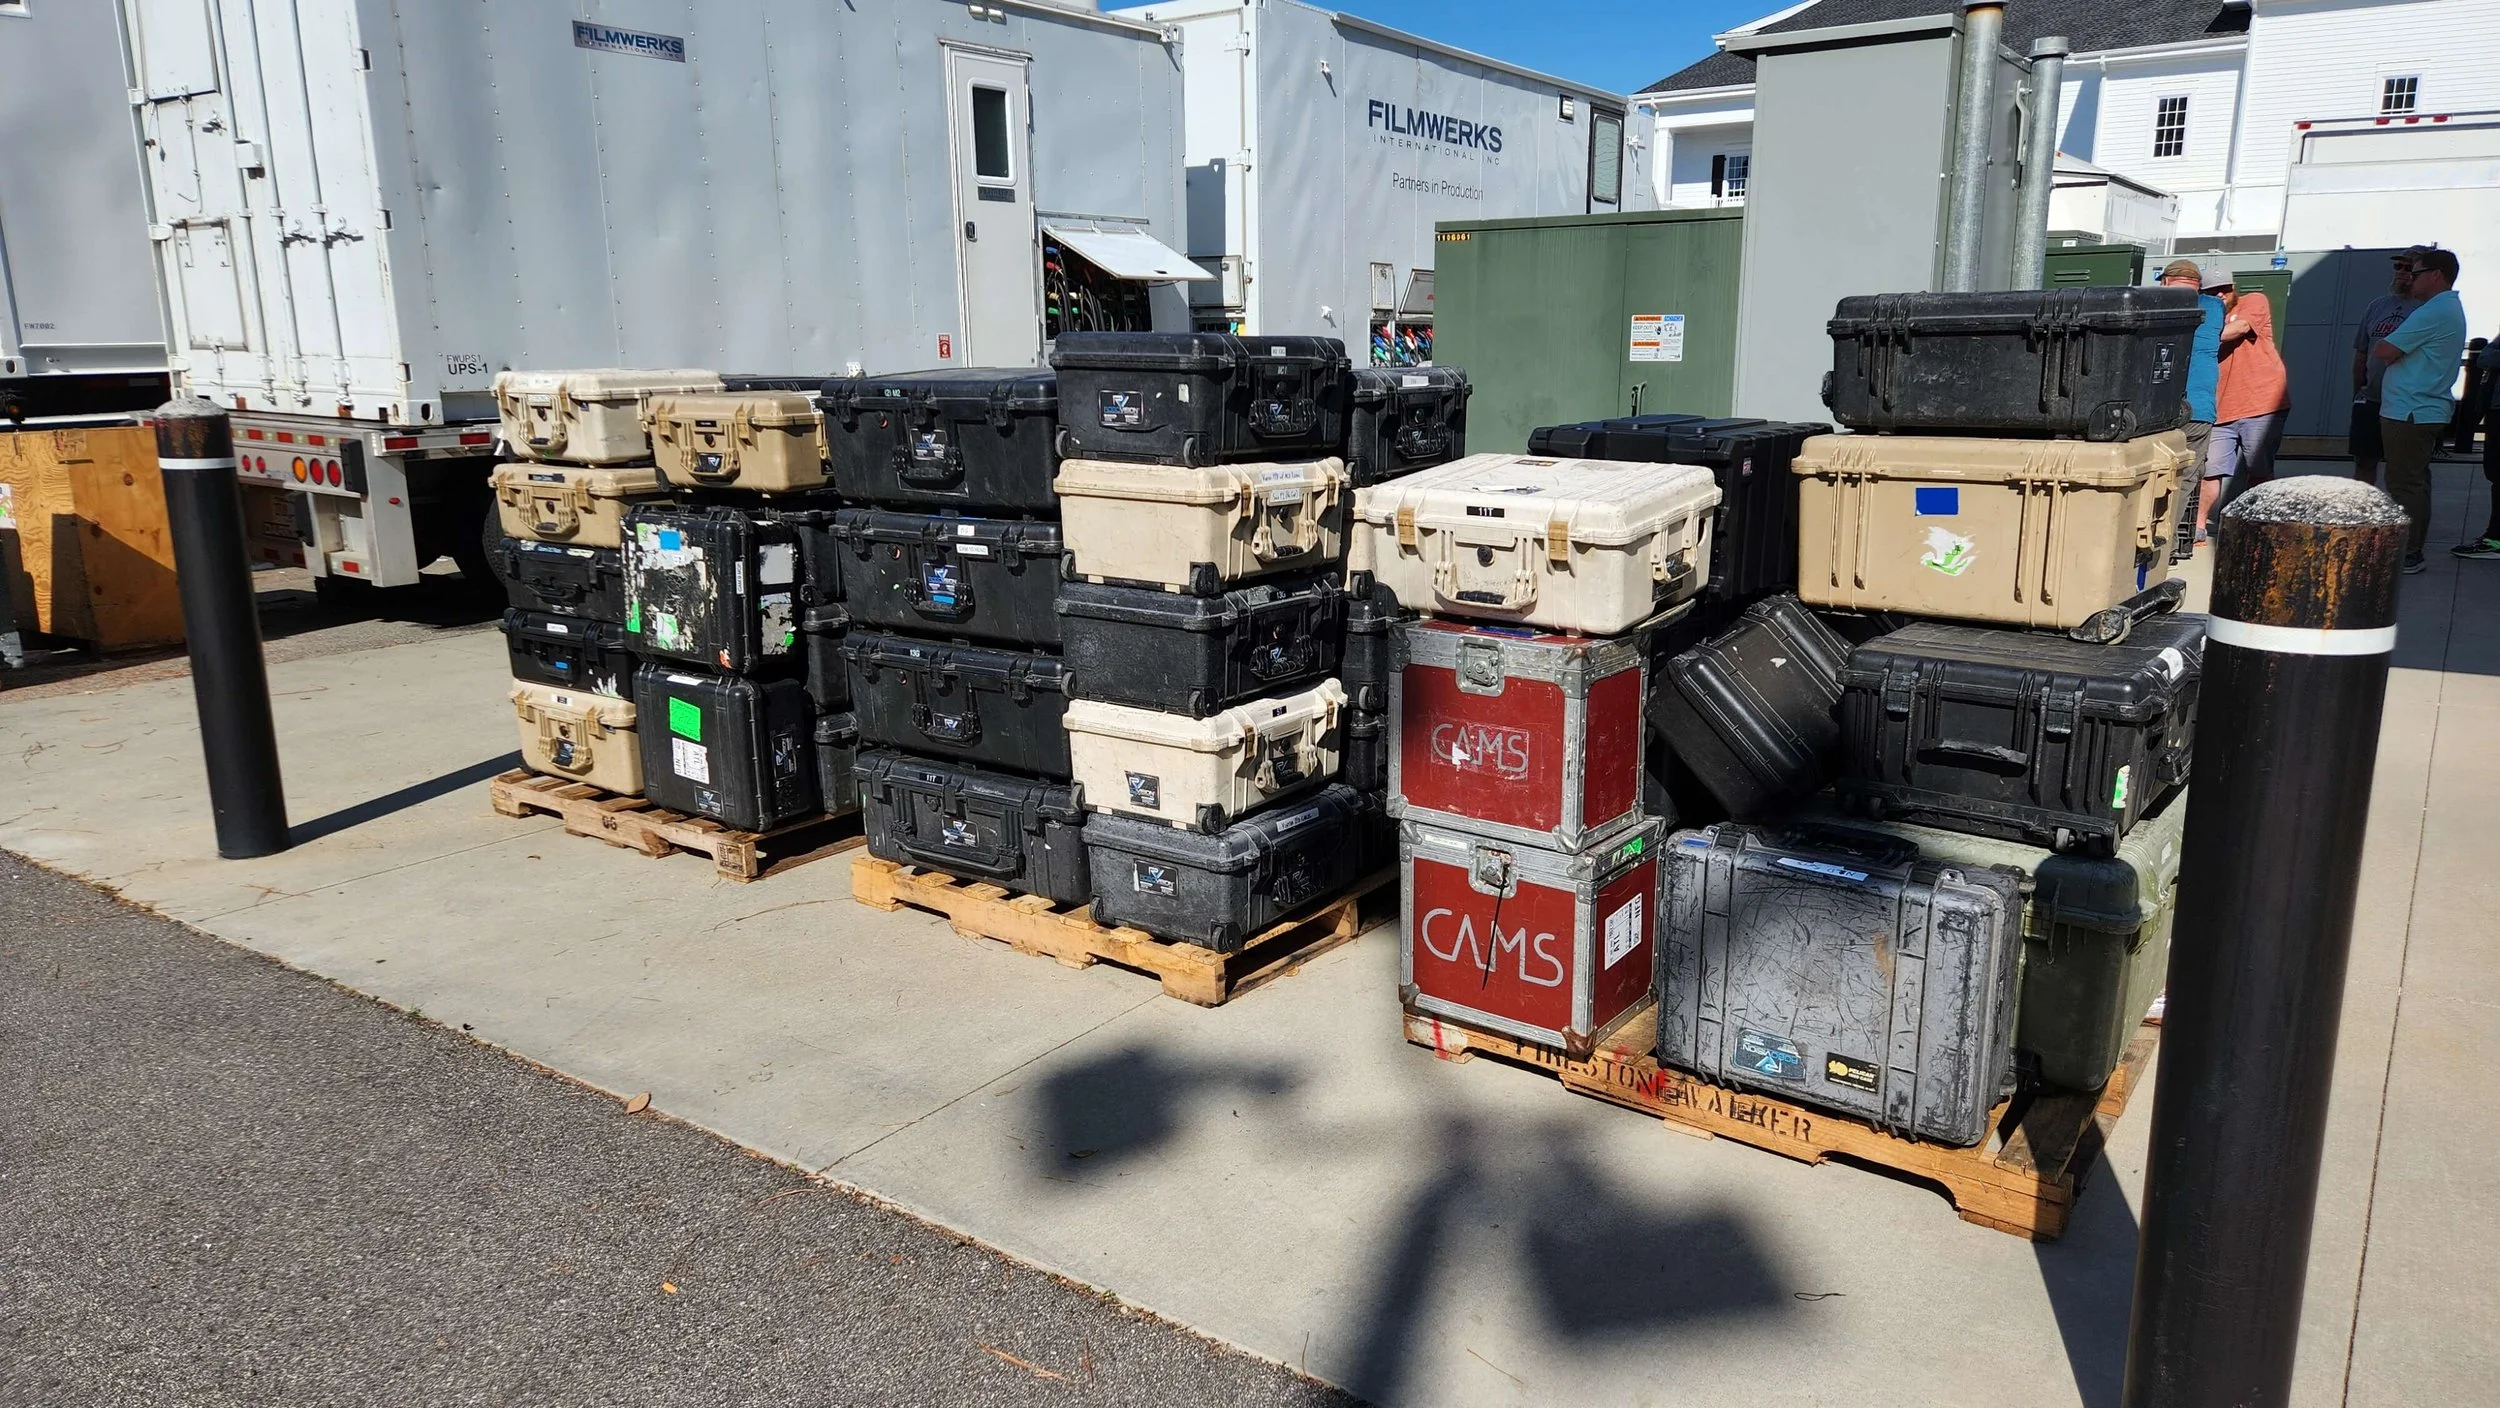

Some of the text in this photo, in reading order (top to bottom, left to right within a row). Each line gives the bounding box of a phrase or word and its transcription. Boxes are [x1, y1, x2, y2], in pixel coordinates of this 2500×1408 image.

[576, 25, 683, 54] FILMWERKS
[1368, 99, 1503, 153] FILMWERKS
[1373, 134, 1500, 166] INTERNATIONAL INC
[1392, 172, 1484, 201] Partners in Production
[446, 354, 481, 363] FWUPS1
[448, 362, 488, 375] UPS-1
[1478, 507, 1495, 517] 11T
[1431, 722, 1529, 773] CAMS
[1421, 907, 1564, 988] CAMS
[1613, 932, 1621, 953] ATL
[1848, 1067, 1875, 1079] PELICAN
